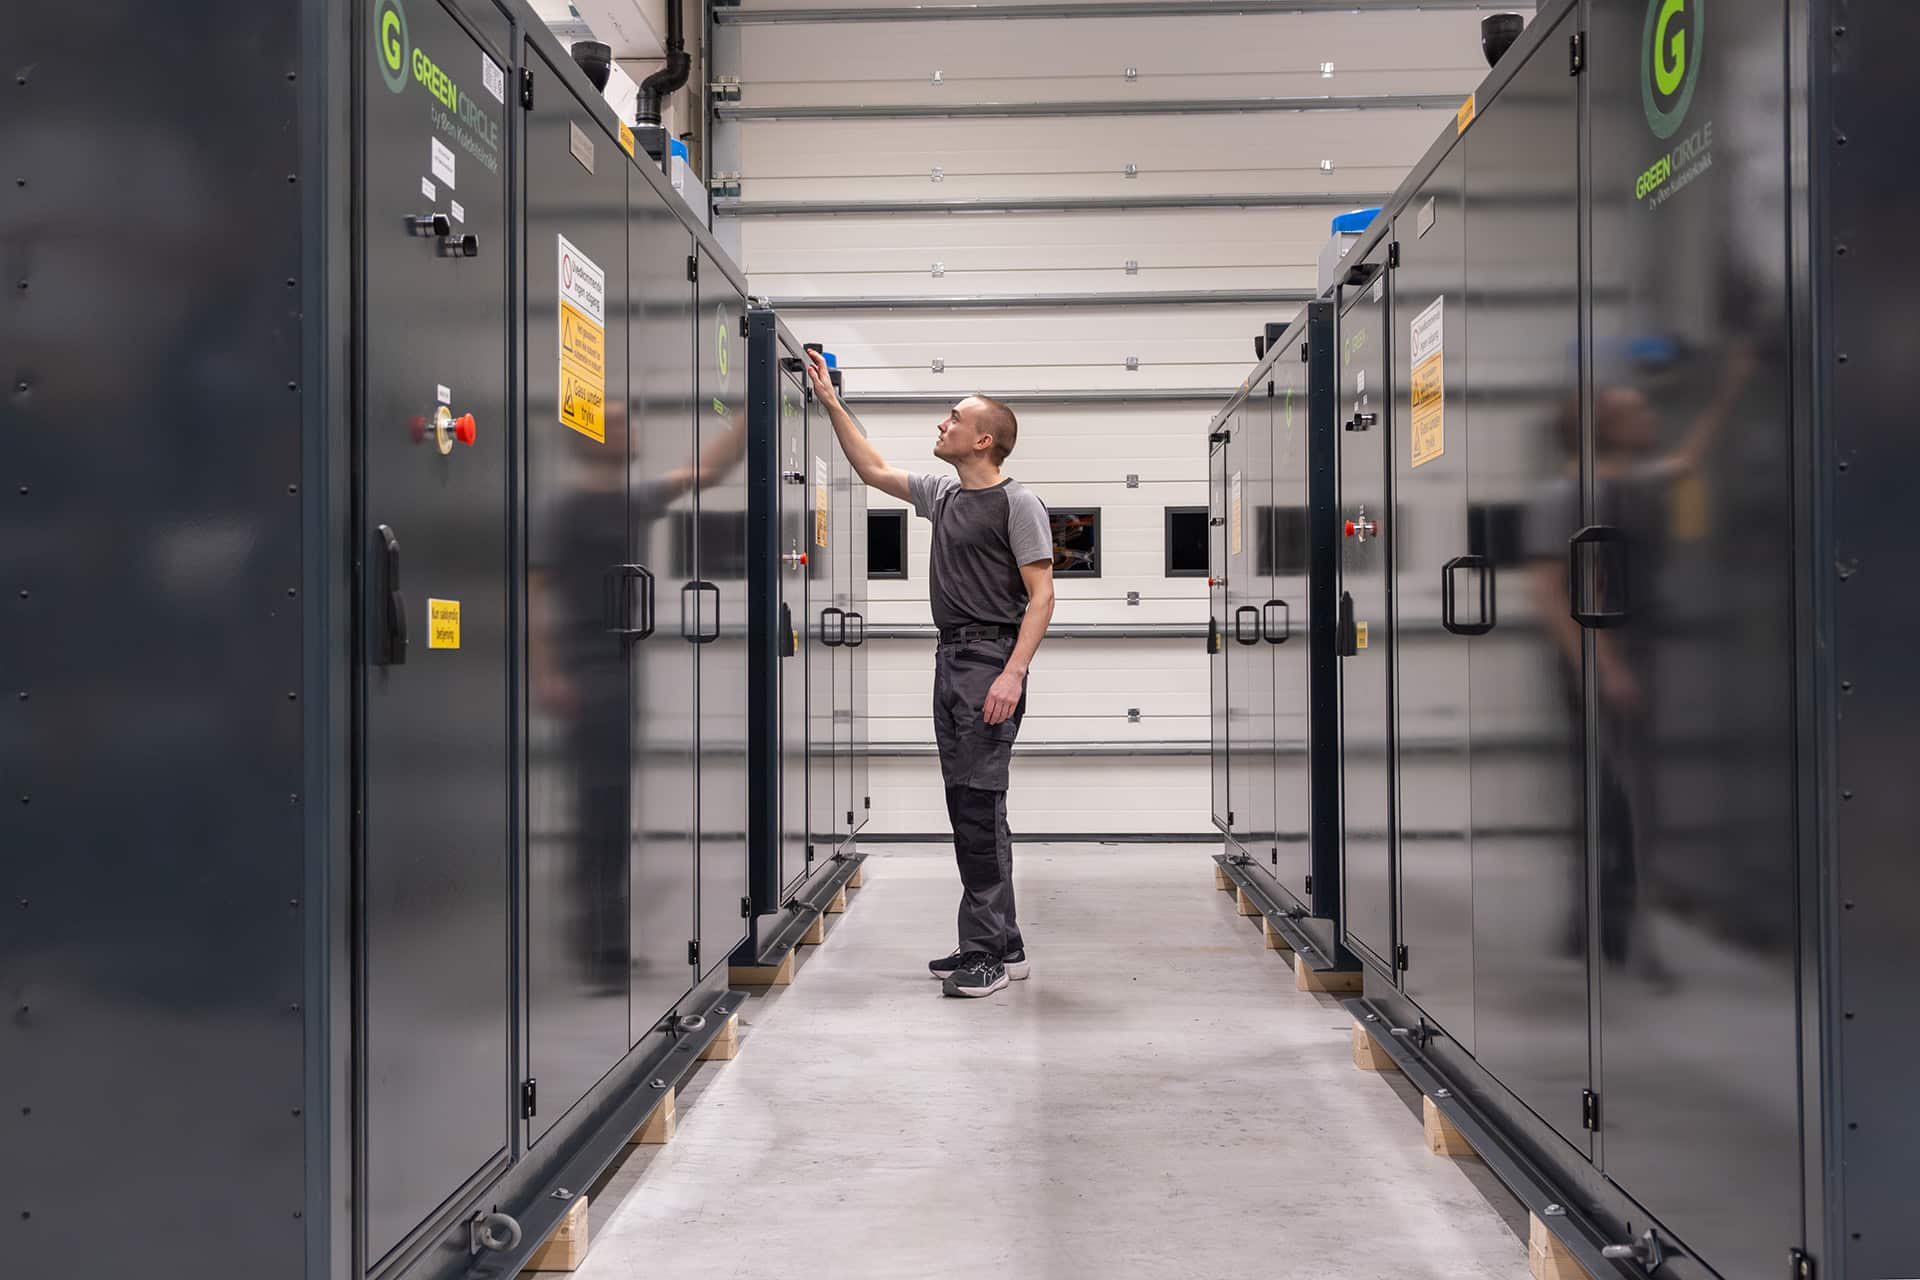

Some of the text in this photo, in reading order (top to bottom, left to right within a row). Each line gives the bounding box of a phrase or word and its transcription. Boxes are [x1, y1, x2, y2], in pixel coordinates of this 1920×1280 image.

[382, 10, 400, 70] G
[1654, 0, 1685, 95] G
[412, 47, 457, 113] GREEN
[458, 91, 498, 152] CIRCLE
[1635, 153, 1671, 200] GREEN
